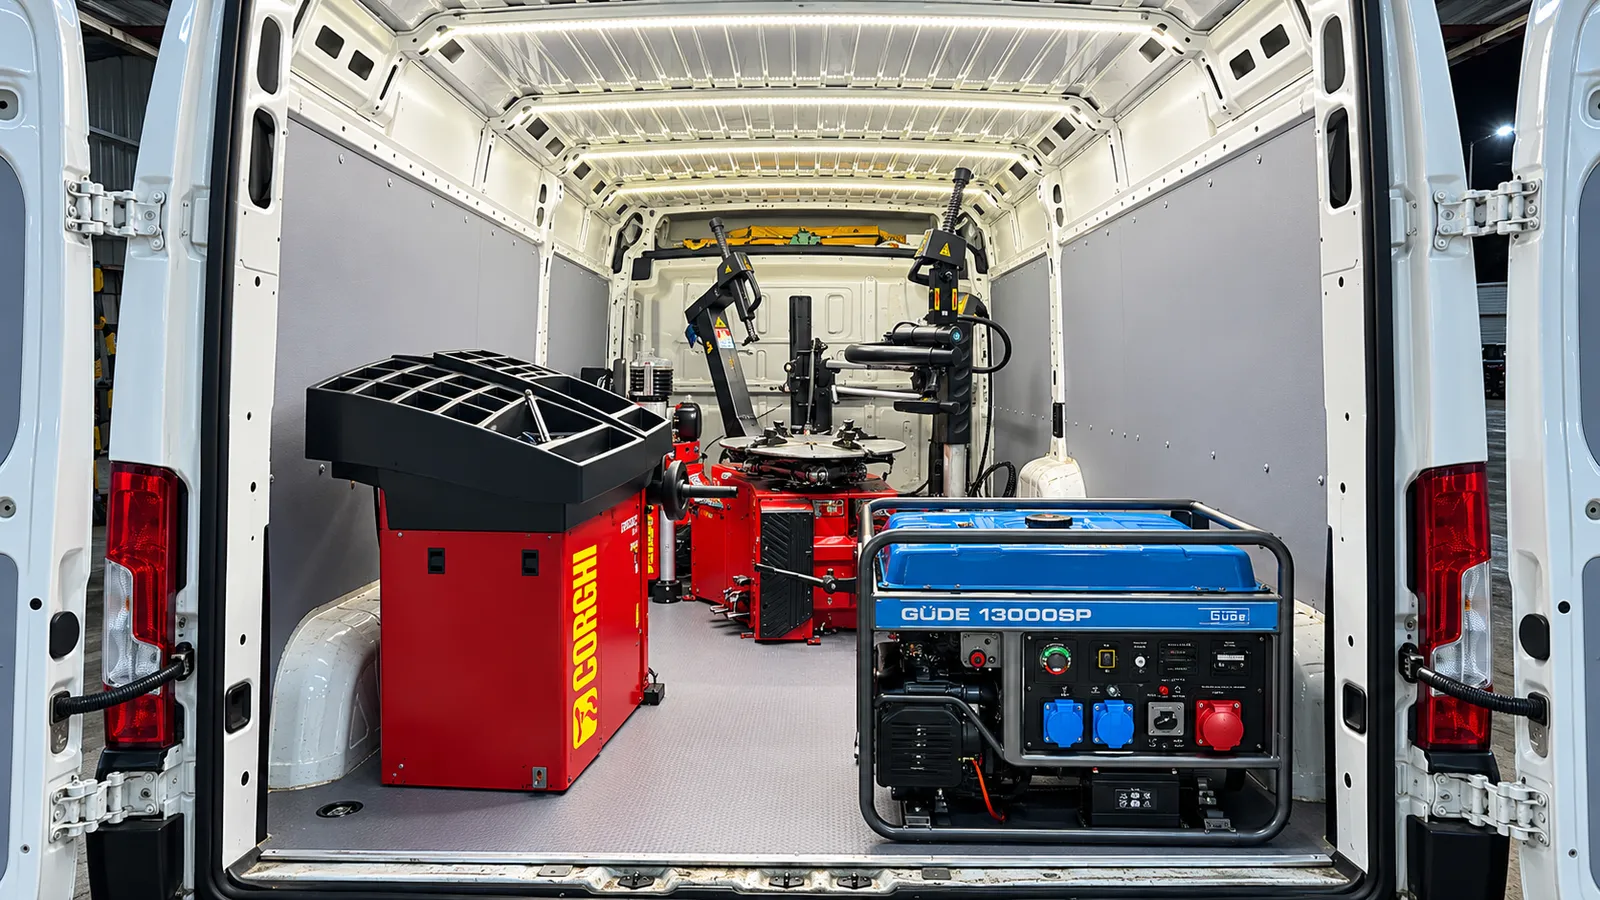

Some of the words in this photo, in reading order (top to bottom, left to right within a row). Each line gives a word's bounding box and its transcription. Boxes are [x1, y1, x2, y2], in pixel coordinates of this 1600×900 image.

[572, 544, 598, 692] CORGHI
[901, 605, 970, 621] GÜDE
[979, 608, 1092, 622] 13000SP
